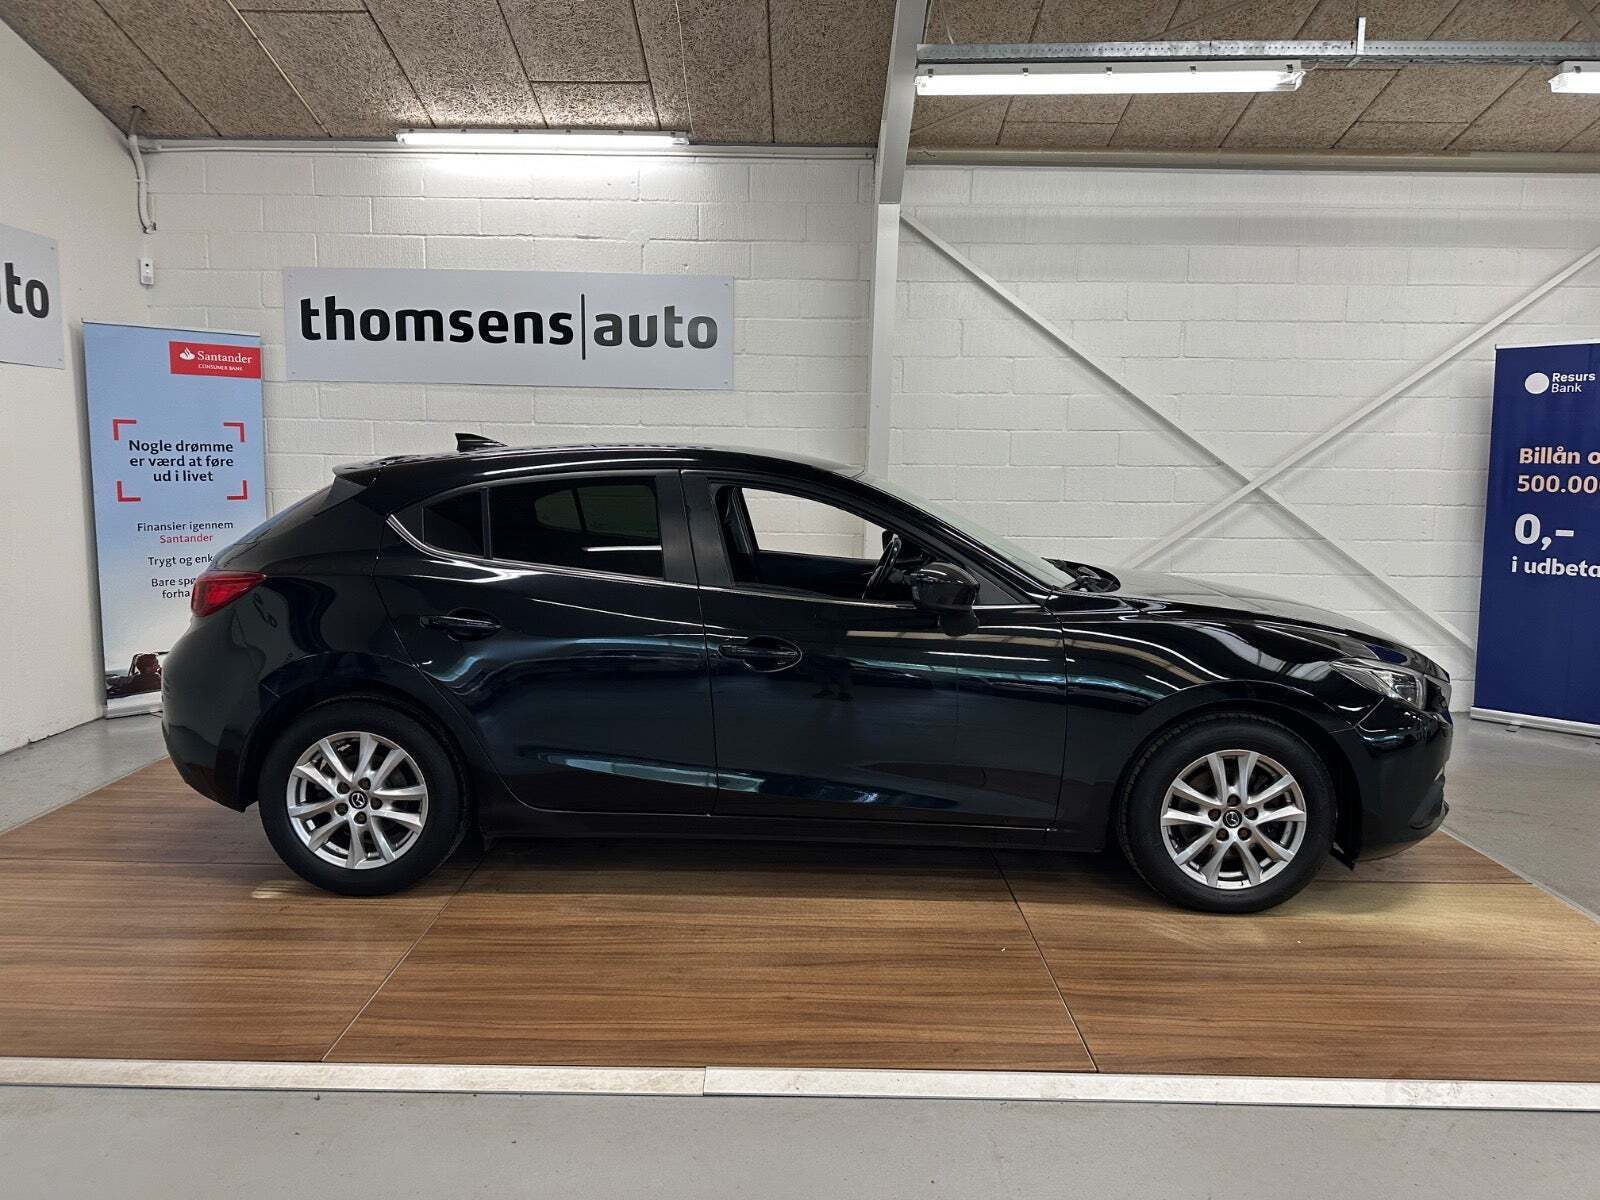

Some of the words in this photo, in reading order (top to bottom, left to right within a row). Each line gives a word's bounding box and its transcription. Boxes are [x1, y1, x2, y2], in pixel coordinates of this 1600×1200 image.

[4, 262, 49, 318] to
[300, 296, 573, 345] thomsens
[593, 305, 719, 349] auto
[197, 350, 252, 363] Santander
[198, 363, 228, 371] CONSUMER
[1552, 372, 1596, 382] Resurs
[1551, 383, 1582, 393] Bank
[128, 440, 172, 455] Nogle
[175, 440, 233, 453] drømme
[129, 457, 145, 467] er
[148, 455, 185, 467] værd
[188, 456, 202, 467] at
[206, 455, 233, 467] føre
[1519, 446, 1581, 465] Billån
[1587, 451, 1600, 465] o
[153, 470, 171, 482] ud
[175, 470, 179, 481] i
[183, 470, 214, 482] livet
[1517, 475, 1600, 494] 500.00
[137, 521, 187, 532] Finansier
[189, 521, 234, 532] igennem
[159, 534, 214, 544] Santander
[147, 556, 176, 568] Trygt
[179, 556, 193, 566] og
[195, 553, 213, 563] enk
[1511, 556, 1518, 573] i
[1524, 557, 1600, 578] udbeta
[151, 578, 176, 587] Bare
[178, 577, 196, 587] spø
[162, 589, 190, 599] forha
